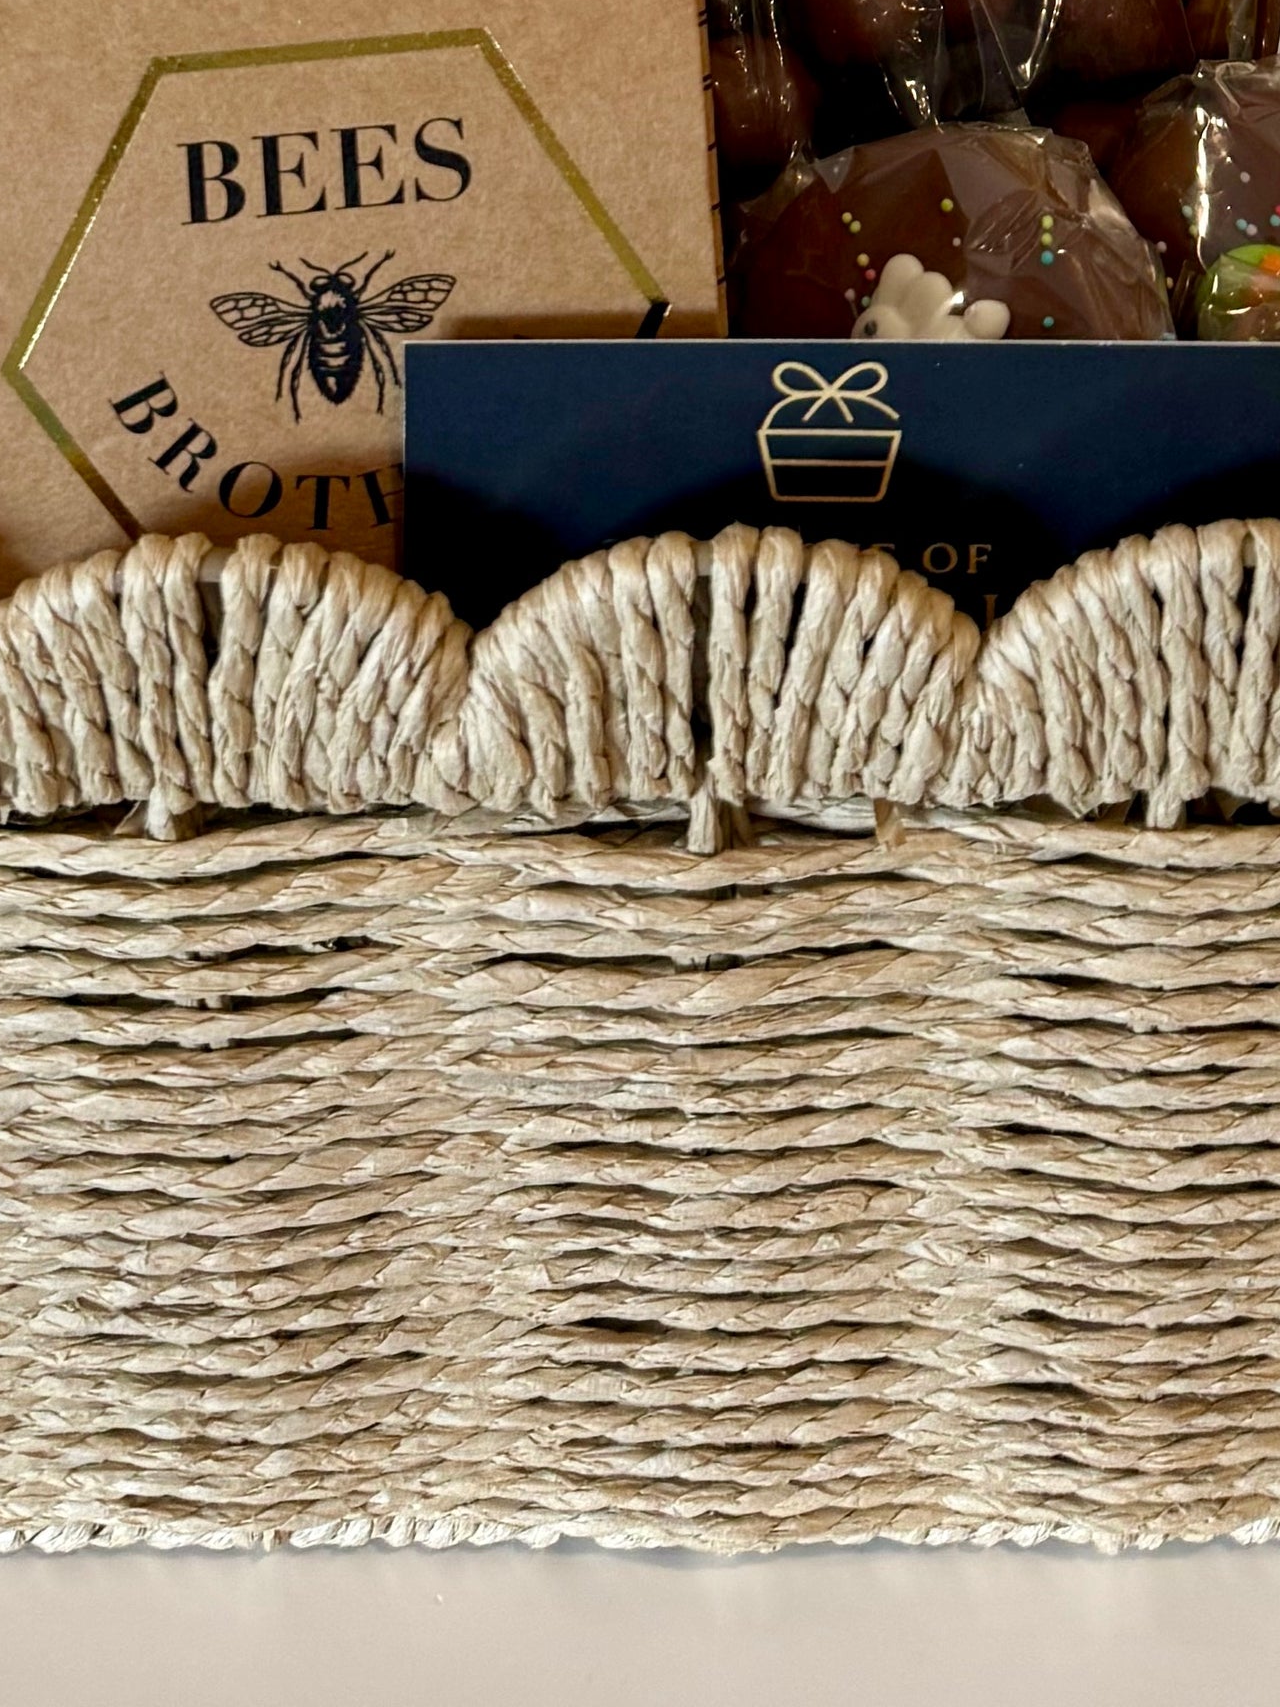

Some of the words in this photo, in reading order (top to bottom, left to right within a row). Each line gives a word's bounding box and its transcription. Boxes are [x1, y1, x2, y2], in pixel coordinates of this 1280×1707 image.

[177, 116, 474, 226] BEES
[108, 371, 404, 531] BROTH
[921, 541, 993, 575] OF
